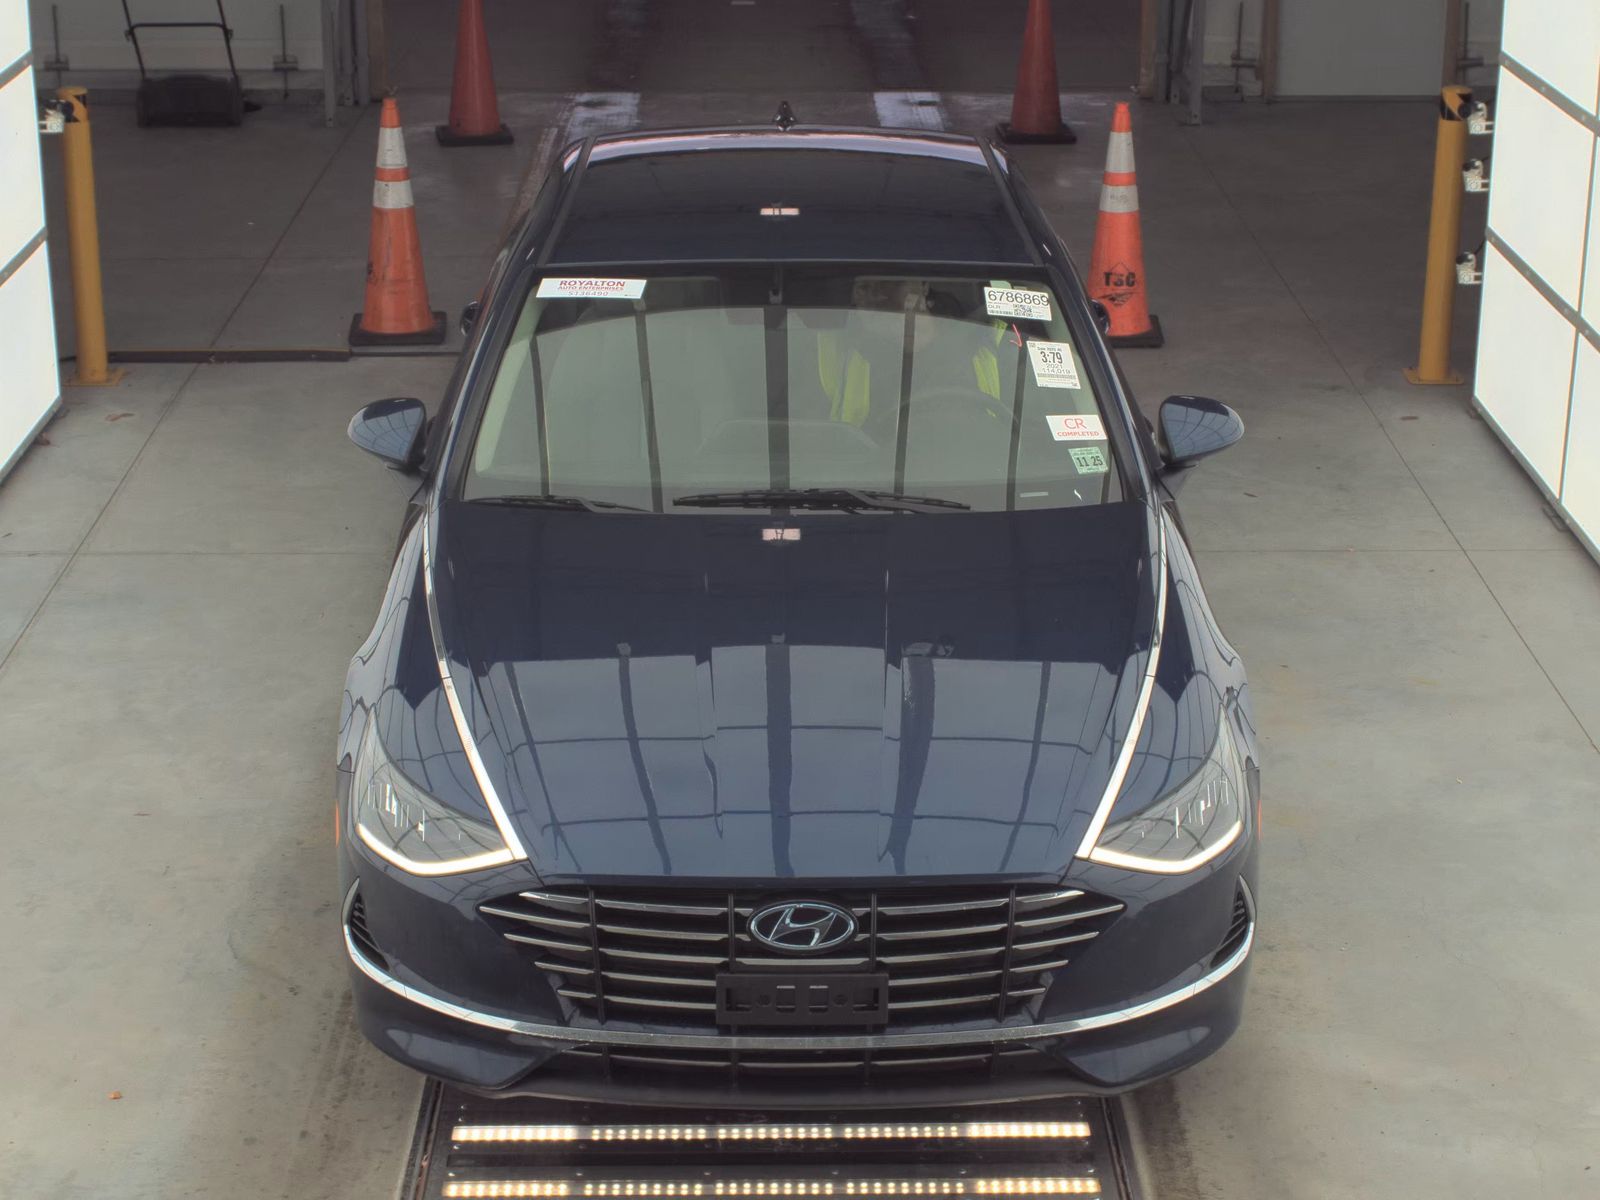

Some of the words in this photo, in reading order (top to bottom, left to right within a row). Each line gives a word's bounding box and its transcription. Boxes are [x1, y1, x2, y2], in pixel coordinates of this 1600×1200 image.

[988, 290, 1050, 306] 6786869
[1064, 418, 1087, 430] CR
[1076, 457, 1090, 467] 11
[1090, 455, 1104, 466] 25
